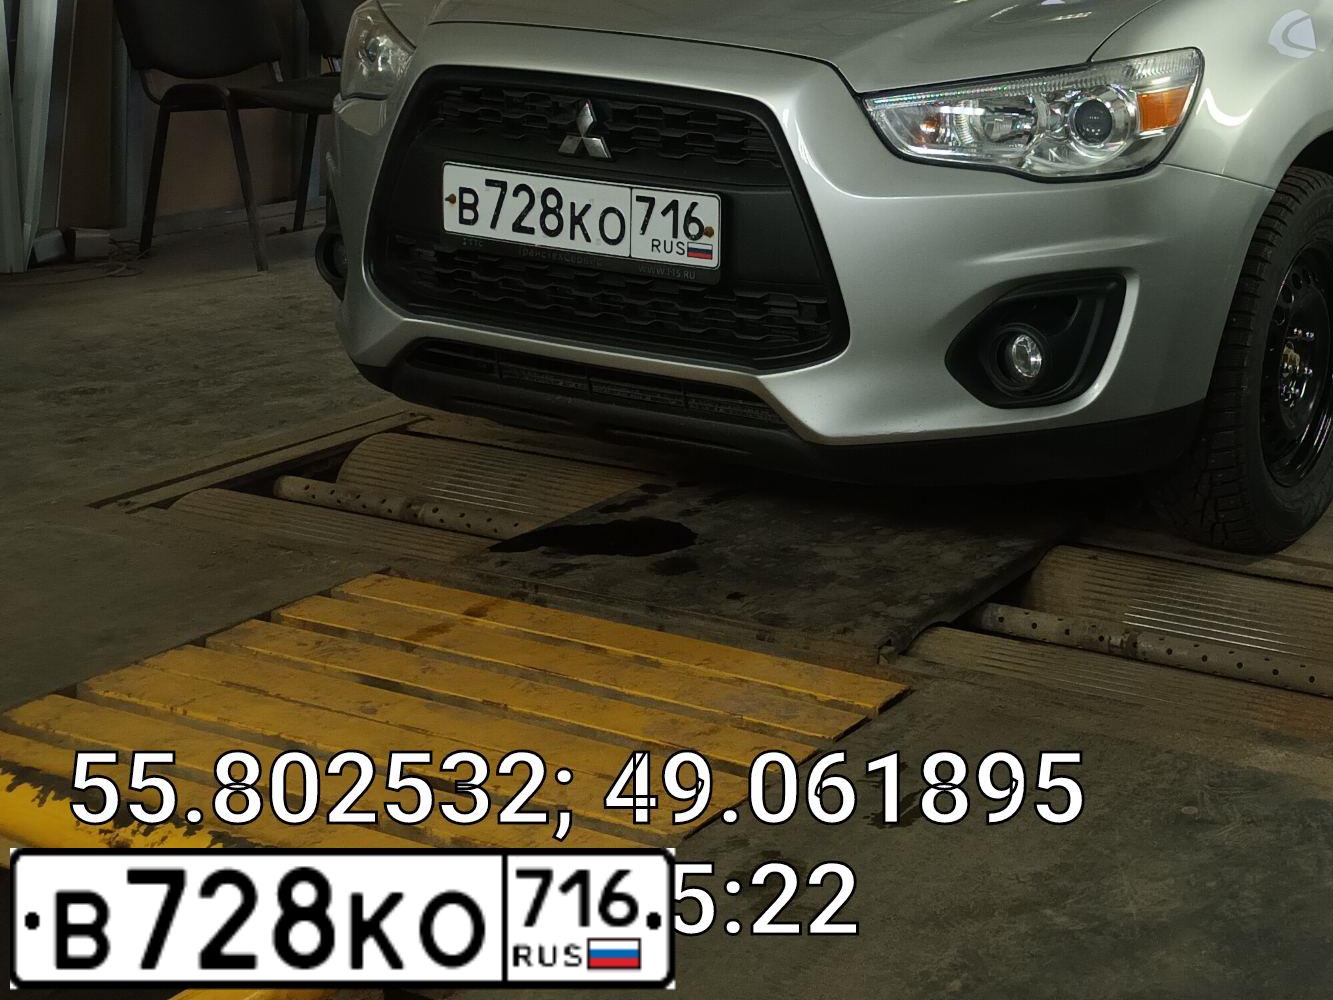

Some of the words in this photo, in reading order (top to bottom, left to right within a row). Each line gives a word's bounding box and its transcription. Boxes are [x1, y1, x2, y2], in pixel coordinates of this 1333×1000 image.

[458, 178, 626, 246] В728КО
[635, 195, 705, 241] 716
[651, 239, 686, 256] RUS
